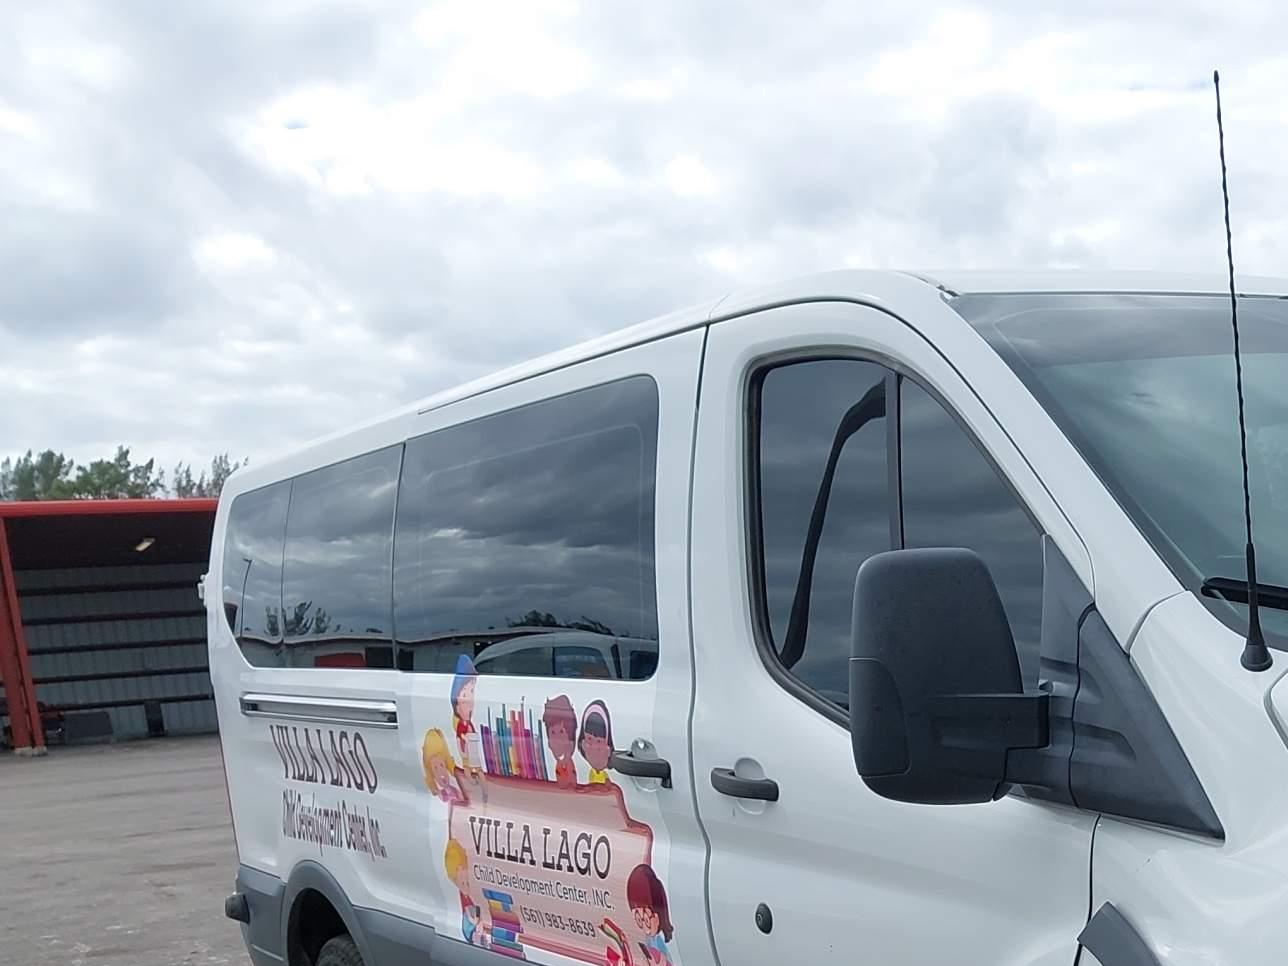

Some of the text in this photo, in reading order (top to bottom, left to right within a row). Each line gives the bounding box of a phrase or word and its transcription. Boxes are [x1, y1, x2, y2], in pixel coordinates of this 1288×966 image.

[269, 724, 378, 794] VILLA LAGO
[469, 815, 611, 880] VILLA LAGO
[473, 864, 495, 884] Child
[496, 868, 555, 898] Development
[592, 889, 616, 911] INC.
[520, 904, 597, 938] (561) 983-8639
